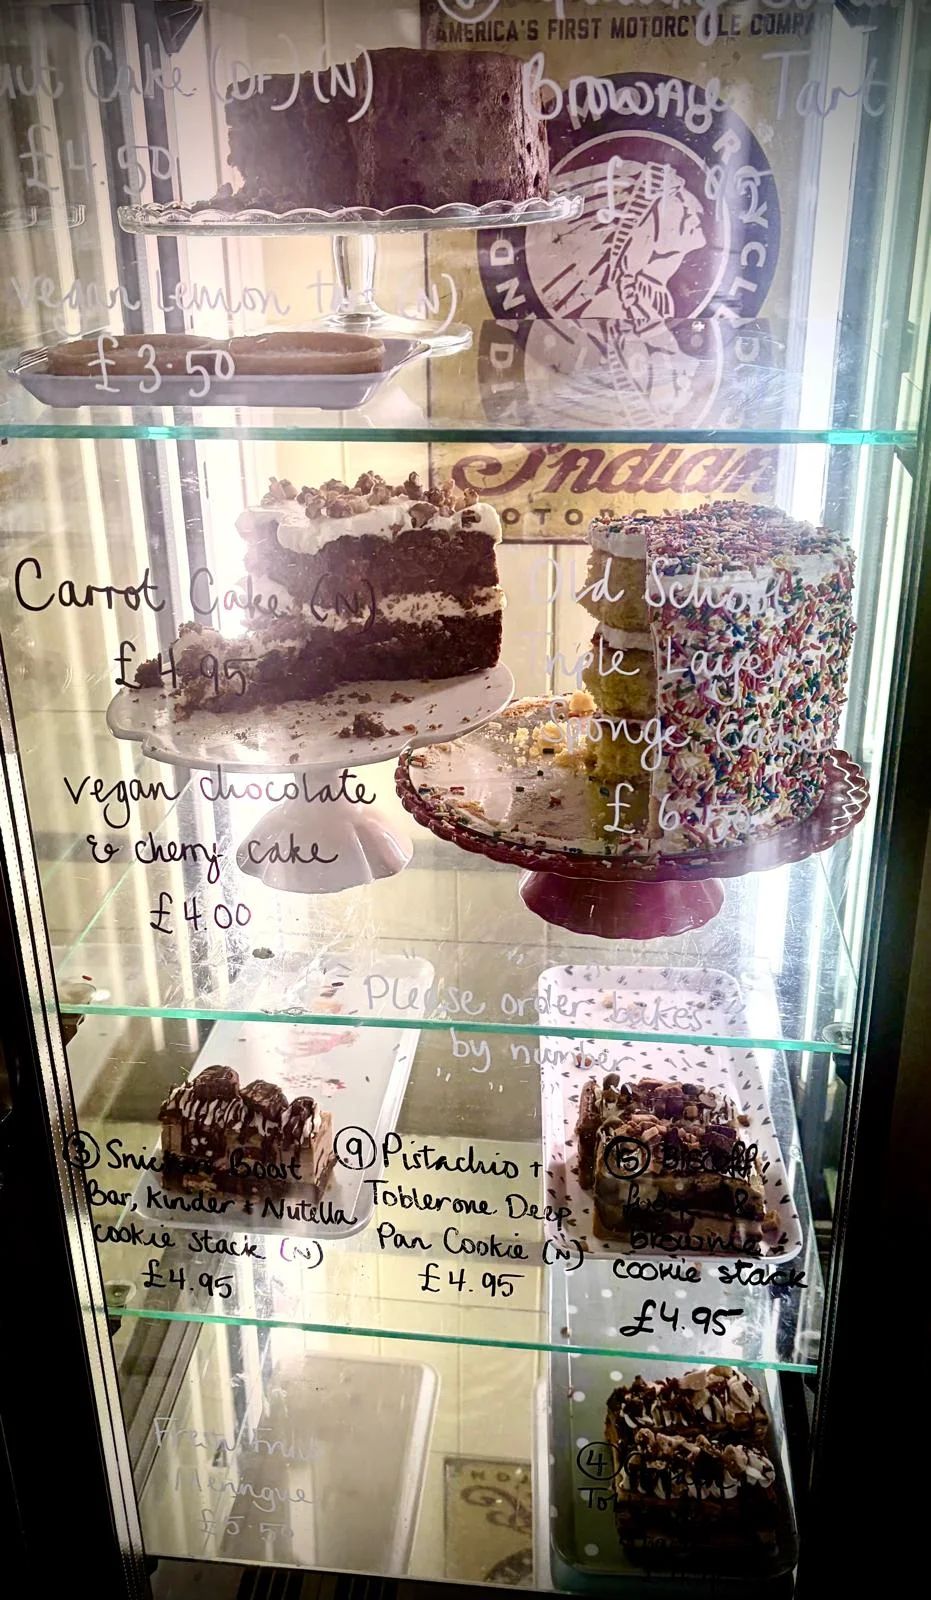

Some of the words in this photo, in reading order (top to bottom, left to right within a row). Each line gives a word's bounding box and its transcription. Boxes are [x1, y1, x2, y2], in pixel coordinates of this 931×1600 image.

[436, 19, 539, 43] AMERICA'S
[547, 17, 601, 40] FIRST
[750, 12, 818, 38] COMPA
[85, 40, 198, 103] Cake
[312, 43, 374, 123] (N)
[761, 49, 889, 120] Tart
[18, 124, 174, 196] £4.50
[87, 335, 236, 397] £3.50
[451, 440, 778, 496] Indian
[14, 556, 166, 612] Carrot
[189, 567, 294, 616] Cake
[529, 556, 625, 606] Old
[541, 699, 690, 770] Sponge
[199, 764, 377, 806] chocolate
[247, 836, 339, 864] cake
[149, 891, 253, 935] £4.00
[500, 984, 596, 1018] order
[449, 1028, 494, 1074] by
[510, 1040, 636, 1074] number
[107, 1138, 214, 1176] Snic
[382, 1132, 520, 1178] Pistachio
[262, 1199, 360, 1226] Nutella
[507, 1194, 575, 1230] Deep
[93, 1223, 176, 1249] cookie
[376, 1221, 434, 1254] Pan
[442, 1227, 530, 1261] Cookie
[540, 1237, 586, 1271] (N)
[141, 1258, 236, 1300] £4.95
[417, 1262, 526, 1299] £4.95
[717, 1258, 809, 1289] stack
[619, 1298, 745, 1338] £4.95
